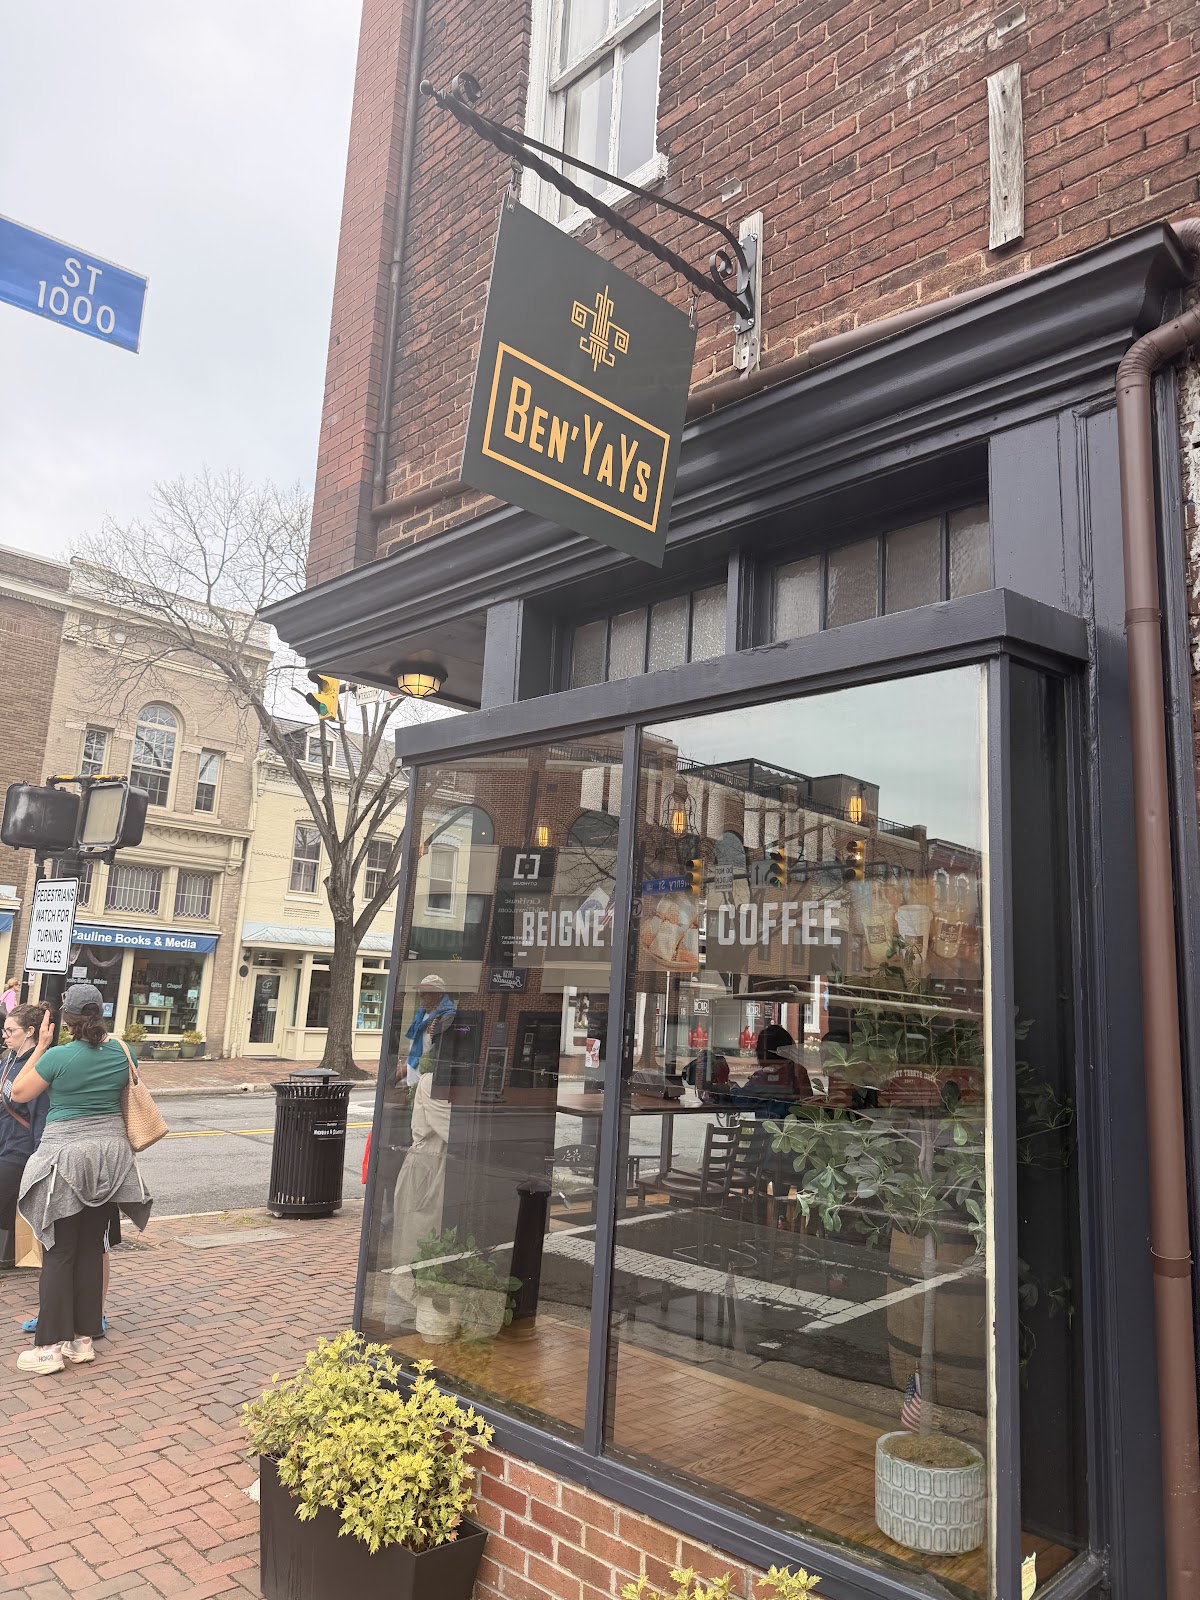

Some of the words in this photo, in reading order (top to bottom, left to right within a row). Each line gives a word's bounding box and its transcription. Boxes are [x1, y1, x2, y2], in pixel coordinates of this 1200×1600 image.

[61, 257, 103, 296] ST
[37, 280, 116, 335] 1000
[36, 888, 75, 902] PEDESTRIANS
[35, 909, 56, 923] WATCH
[56, 909, 70, 922] FOR
[717, 900, 842, 945] COFFEE
[36, 929, 63, 943] TURNING
[71, 929, 112, 943] Pauline
[115, 933, 151, 947] Books
[153, 937, 163, 946] &
[165, 938, 197, 949] Media
[33, 949, 62, 964] VEHICLES
